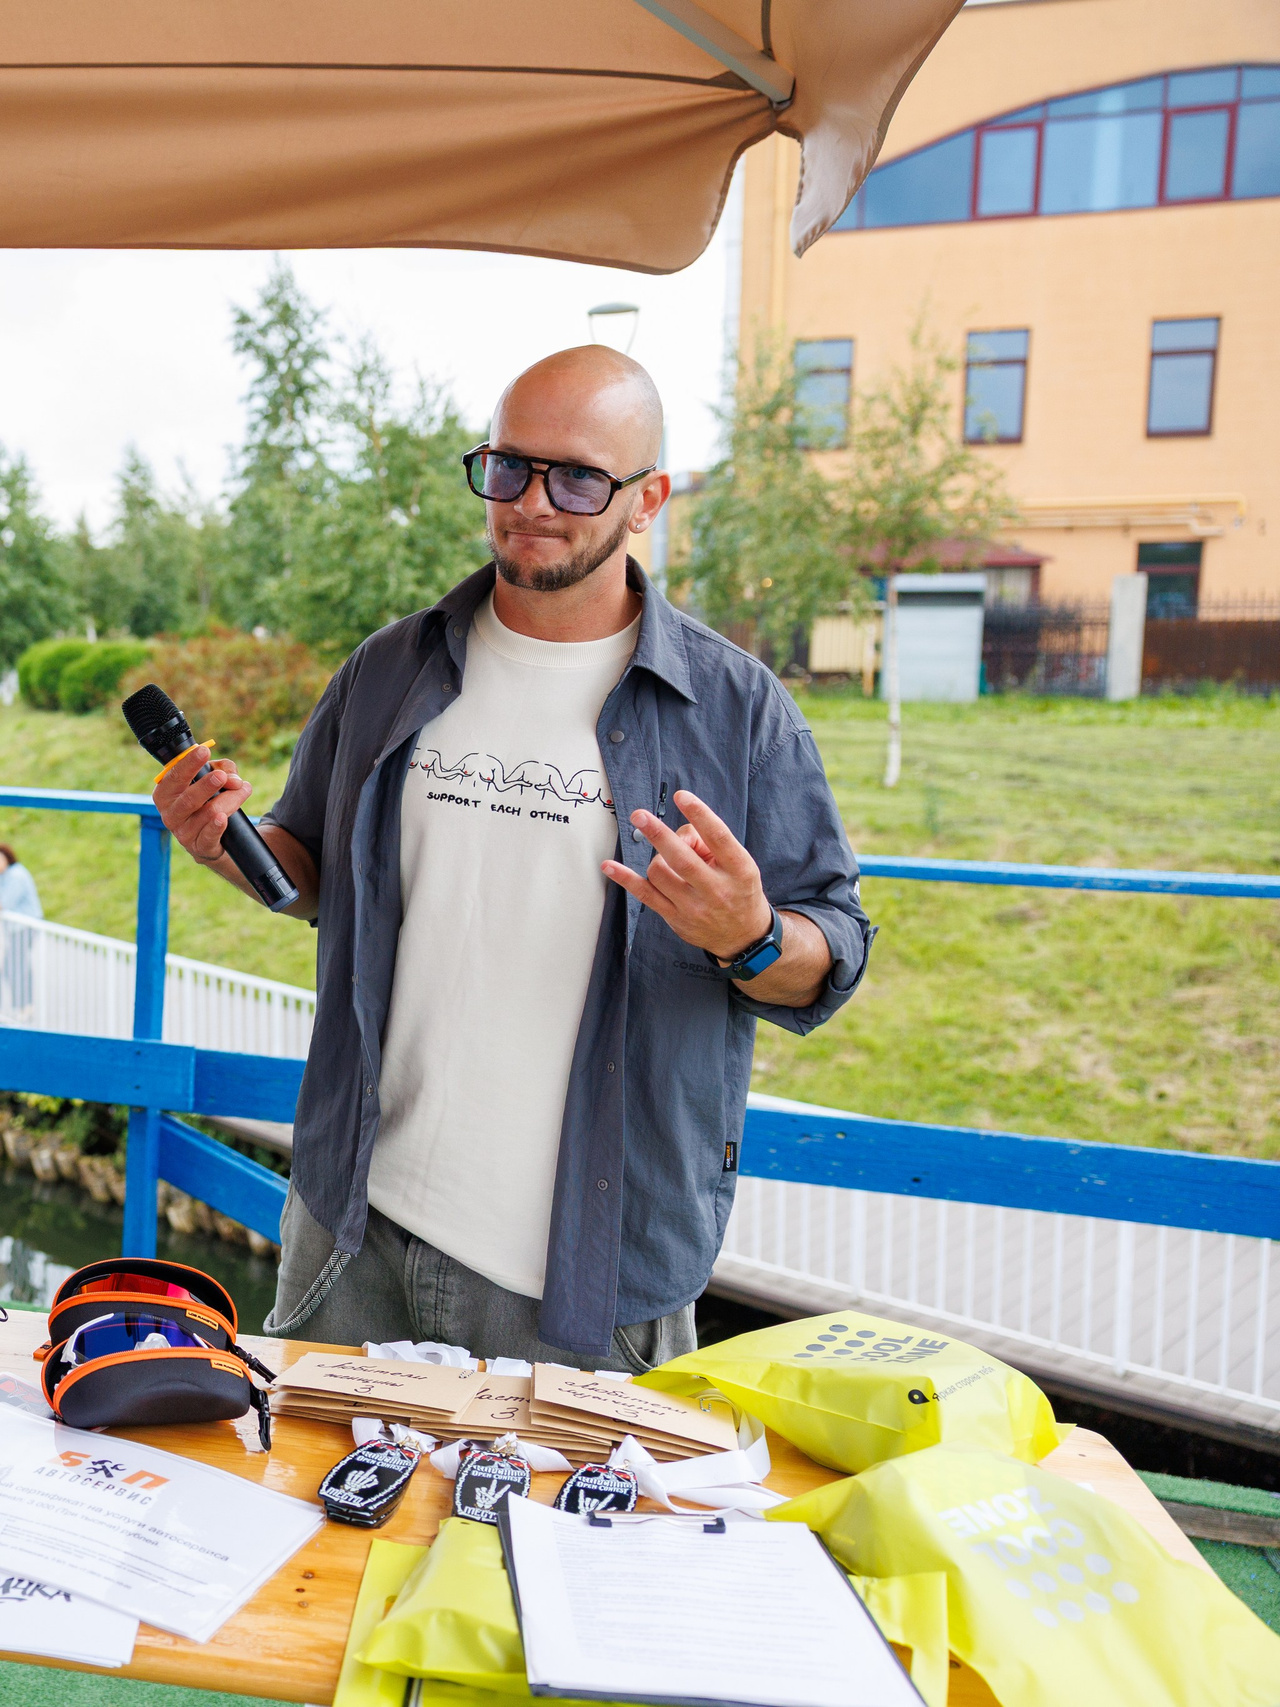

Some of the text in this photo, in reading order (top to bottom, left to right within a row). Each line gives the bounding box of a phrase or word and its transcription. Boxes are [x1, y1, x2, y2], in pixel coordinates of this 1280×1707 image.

[426, 791, 570, 824] SUPPORT EACH OTHER
[883, 1338, 950, 1364] ZONE
[956, 1372, 981, 1392] сторона
[979, 1365, 995, 1380] тебя
[356, 1455, 407, 1473] OPEN CONTEST
[471, 1470, 523, 1484] OPEN CONTEST
[33, 1466, 152, 1506] АВТОСЕРВИС
[576, 1481, 630, 1496] OPEN CONTEST
[18, 1483, 86, 1507] сертификат
[87, 1503, 104, 1513] на
[105, 1509, 147, 1531] услуги
[147, 1525, 230, 1562] автосервиса
[937, 1485, 1056, 1539] ZONE
[970, 1517, 1086, 1572] COOL
